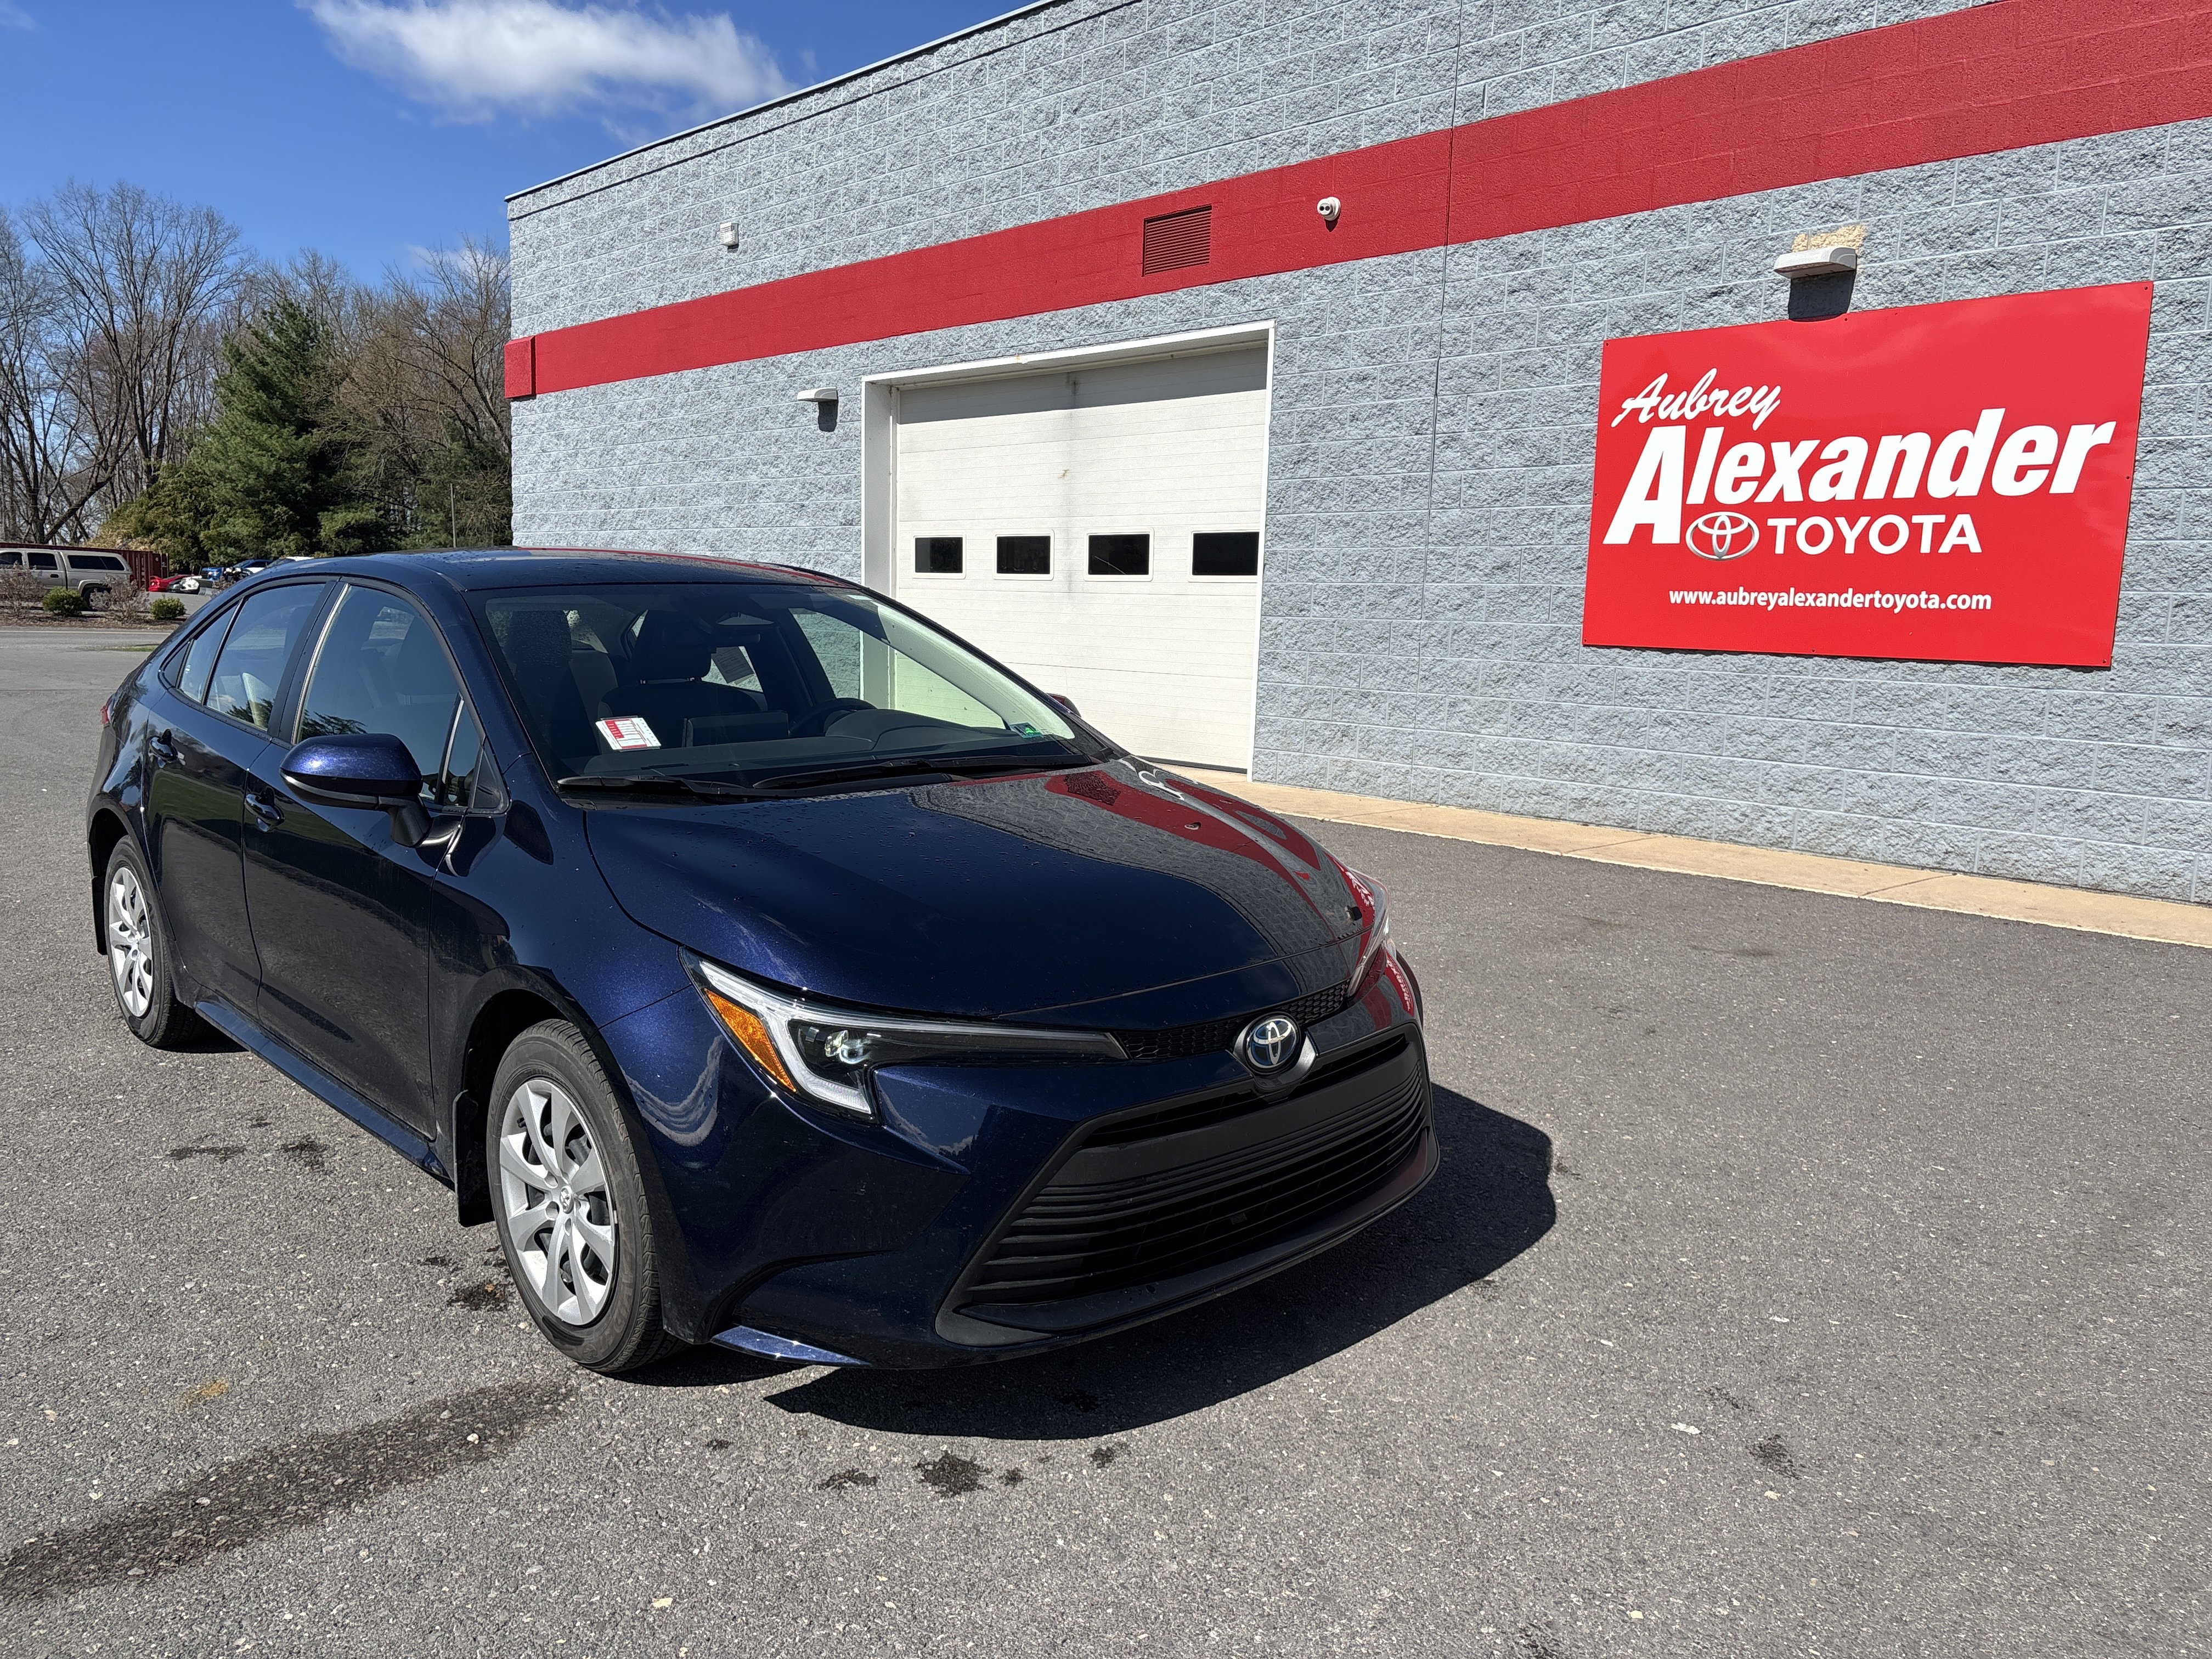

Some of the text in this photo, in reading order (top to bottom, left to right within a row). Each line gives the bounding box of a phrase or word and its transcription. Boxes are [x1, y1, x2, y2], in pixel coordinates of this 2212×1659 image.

[1611, 368, 1781, 431] Aubrey
[1602, 408, 2116, 544] Alexander
[1767, 514, 1982, 555] TOYOTA
[1669, 587, 1991, 614] www.aubreyalexandertoyota.com
